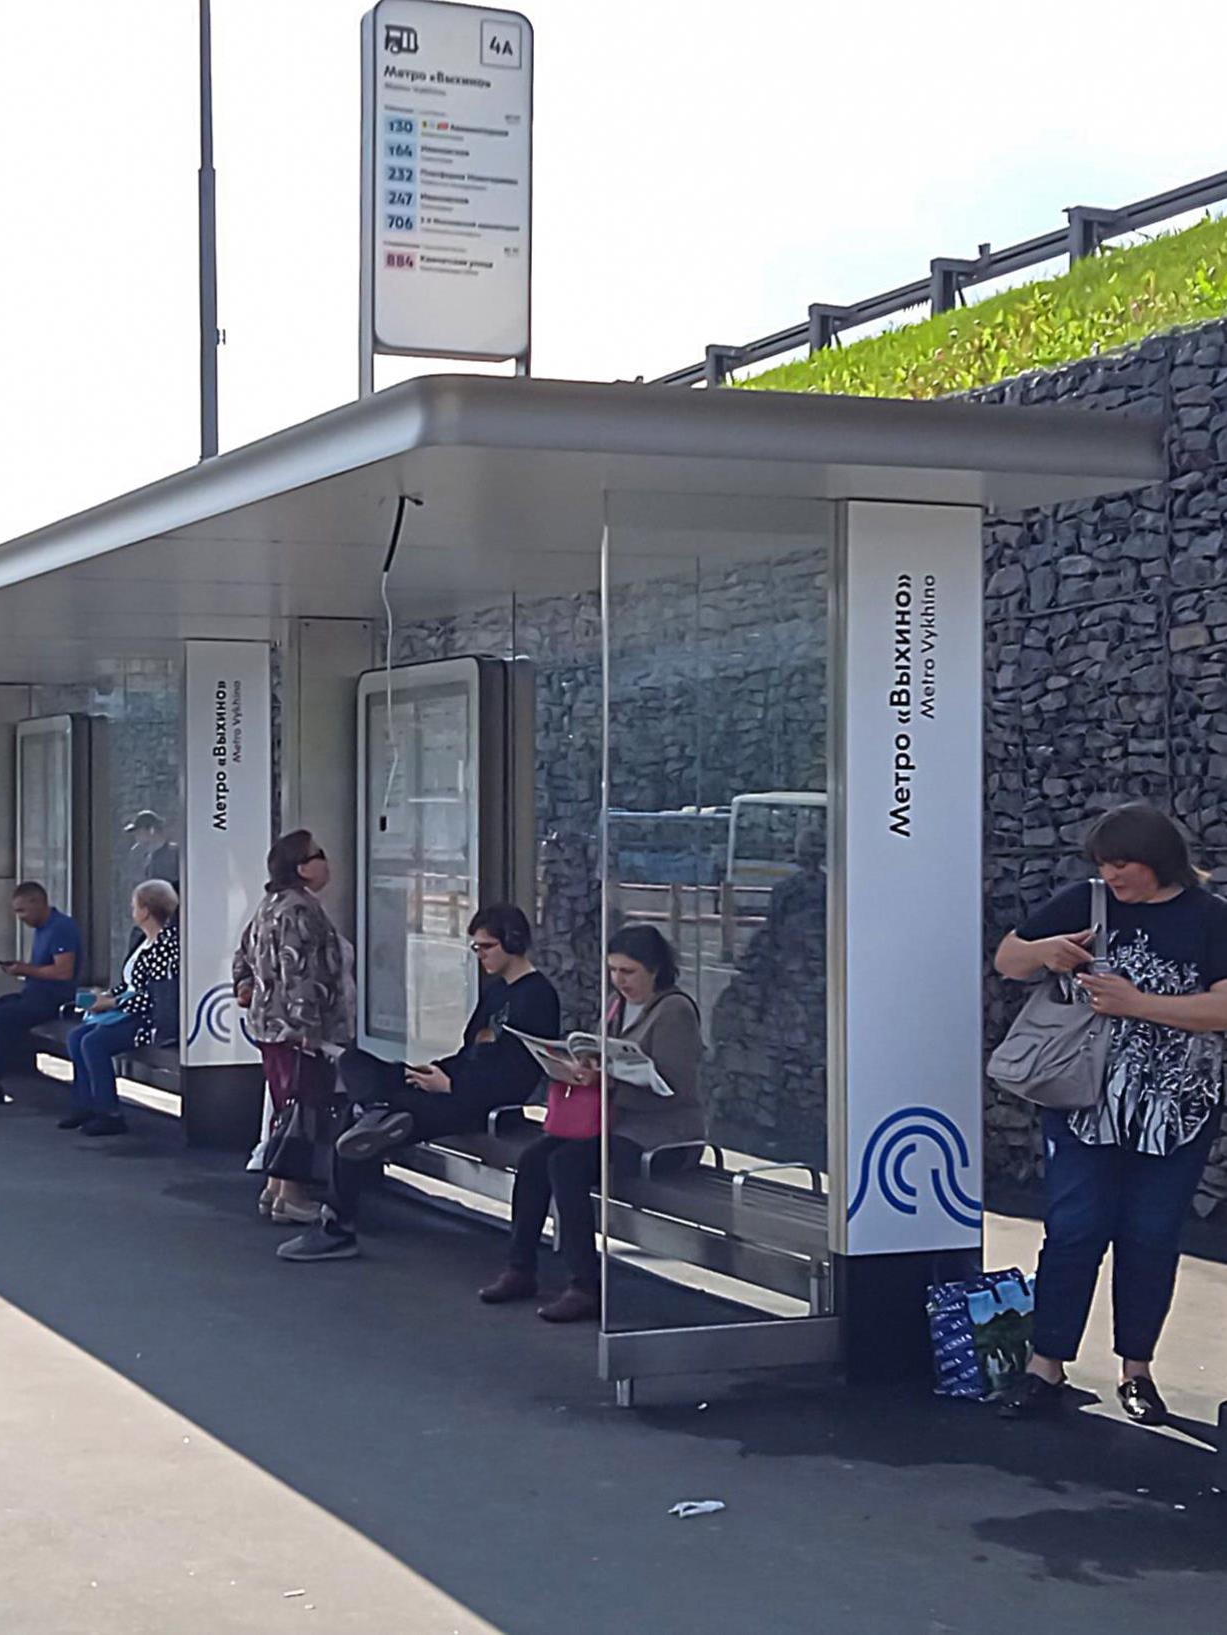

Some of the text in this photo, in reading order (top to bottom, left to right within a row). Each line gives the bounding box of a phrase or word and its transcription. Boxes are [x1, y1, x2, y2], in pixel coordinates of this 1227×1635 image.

[383, 65, 427, 83] Метро
[388, 166, 414, 183] 232
[388, 190, 413, 206] 247
[387, 214, 414, 231] 706
[920, 574, 938, 720] Metro Vykhino
[232, 680, 243, 763] Metro Vykhino
[889, 574, 916, 838] Метро «Выхино»
[212, 680, 230, 831] Метро «Выхино»
